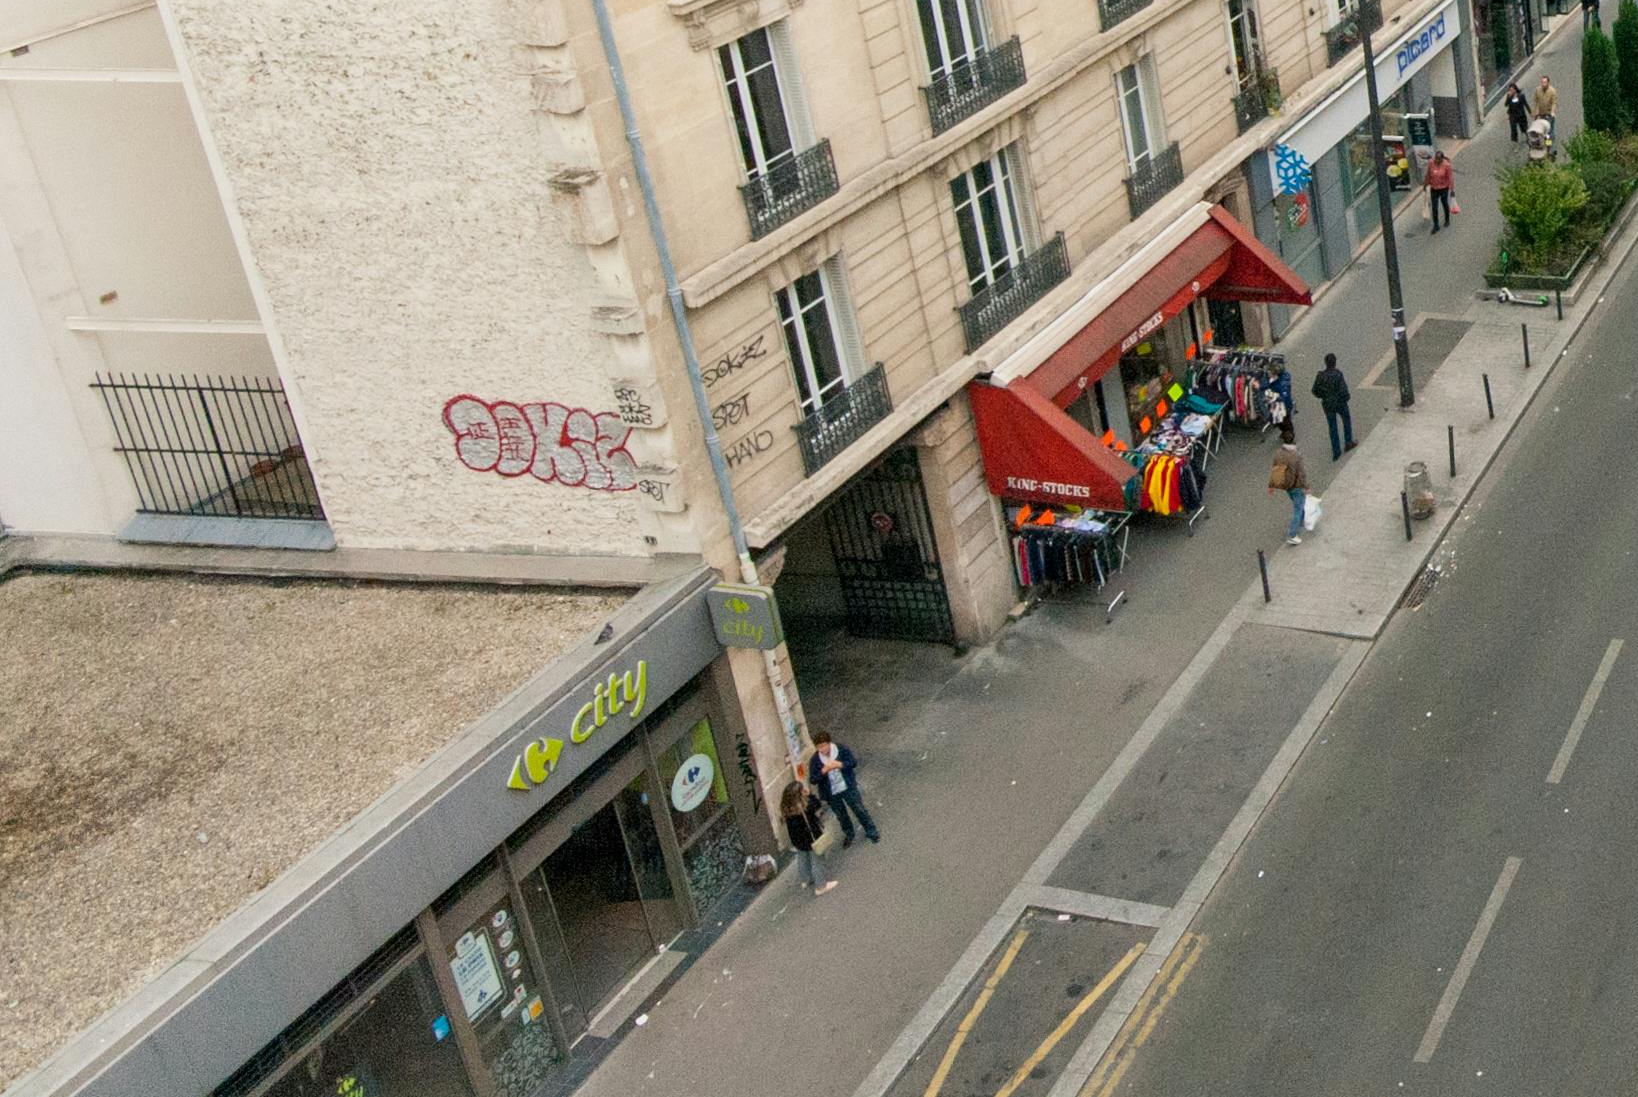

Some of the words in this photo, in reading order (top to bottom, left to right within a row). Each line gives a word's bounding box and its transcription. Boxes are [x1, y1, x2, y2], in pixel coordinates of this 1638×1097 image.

[1396, 11, 1446, 80] picard
[1007, 476, 1091, 498] KING-STOCKS
[722, 616, 764, 644] city
[571, 660, 647, 743] city
